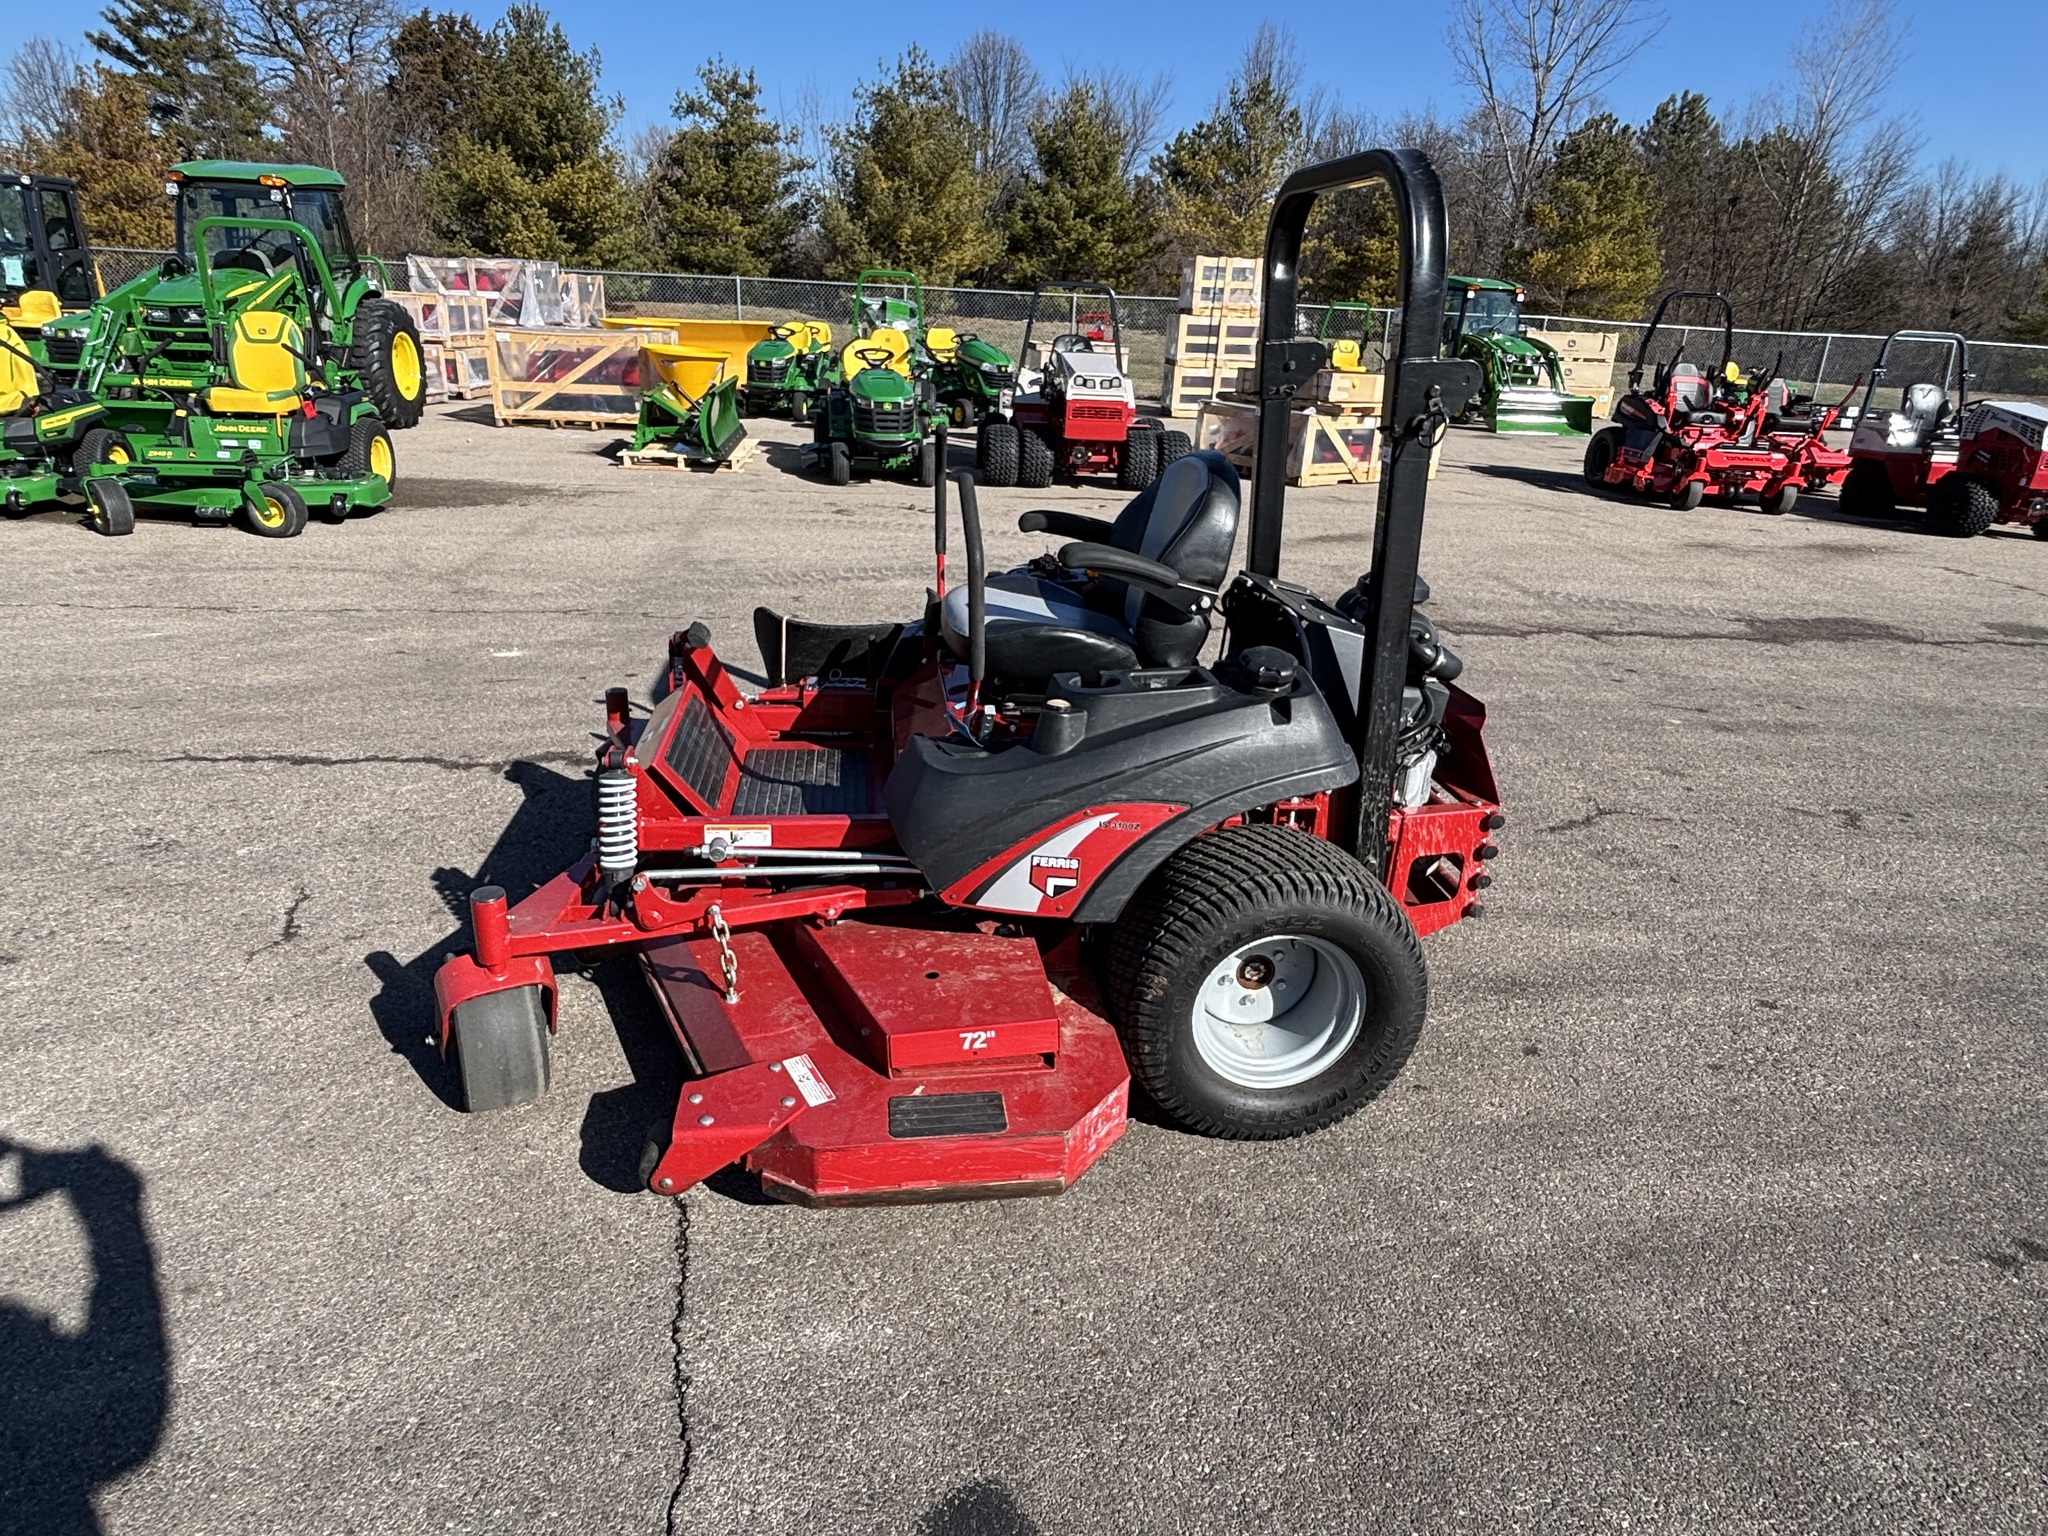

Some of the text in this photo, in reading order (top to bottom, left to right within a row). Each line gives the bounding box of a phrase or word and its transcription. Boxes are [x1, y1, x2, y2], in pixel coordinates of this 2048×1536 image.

[1111, 822, 1140, 831] 3100Z
[1032, 856, 1079, 869] FERRIS
[959, 1030, 996, 1050] 72"
[1223, 1025, 1401, 1125] TURF MASTER
